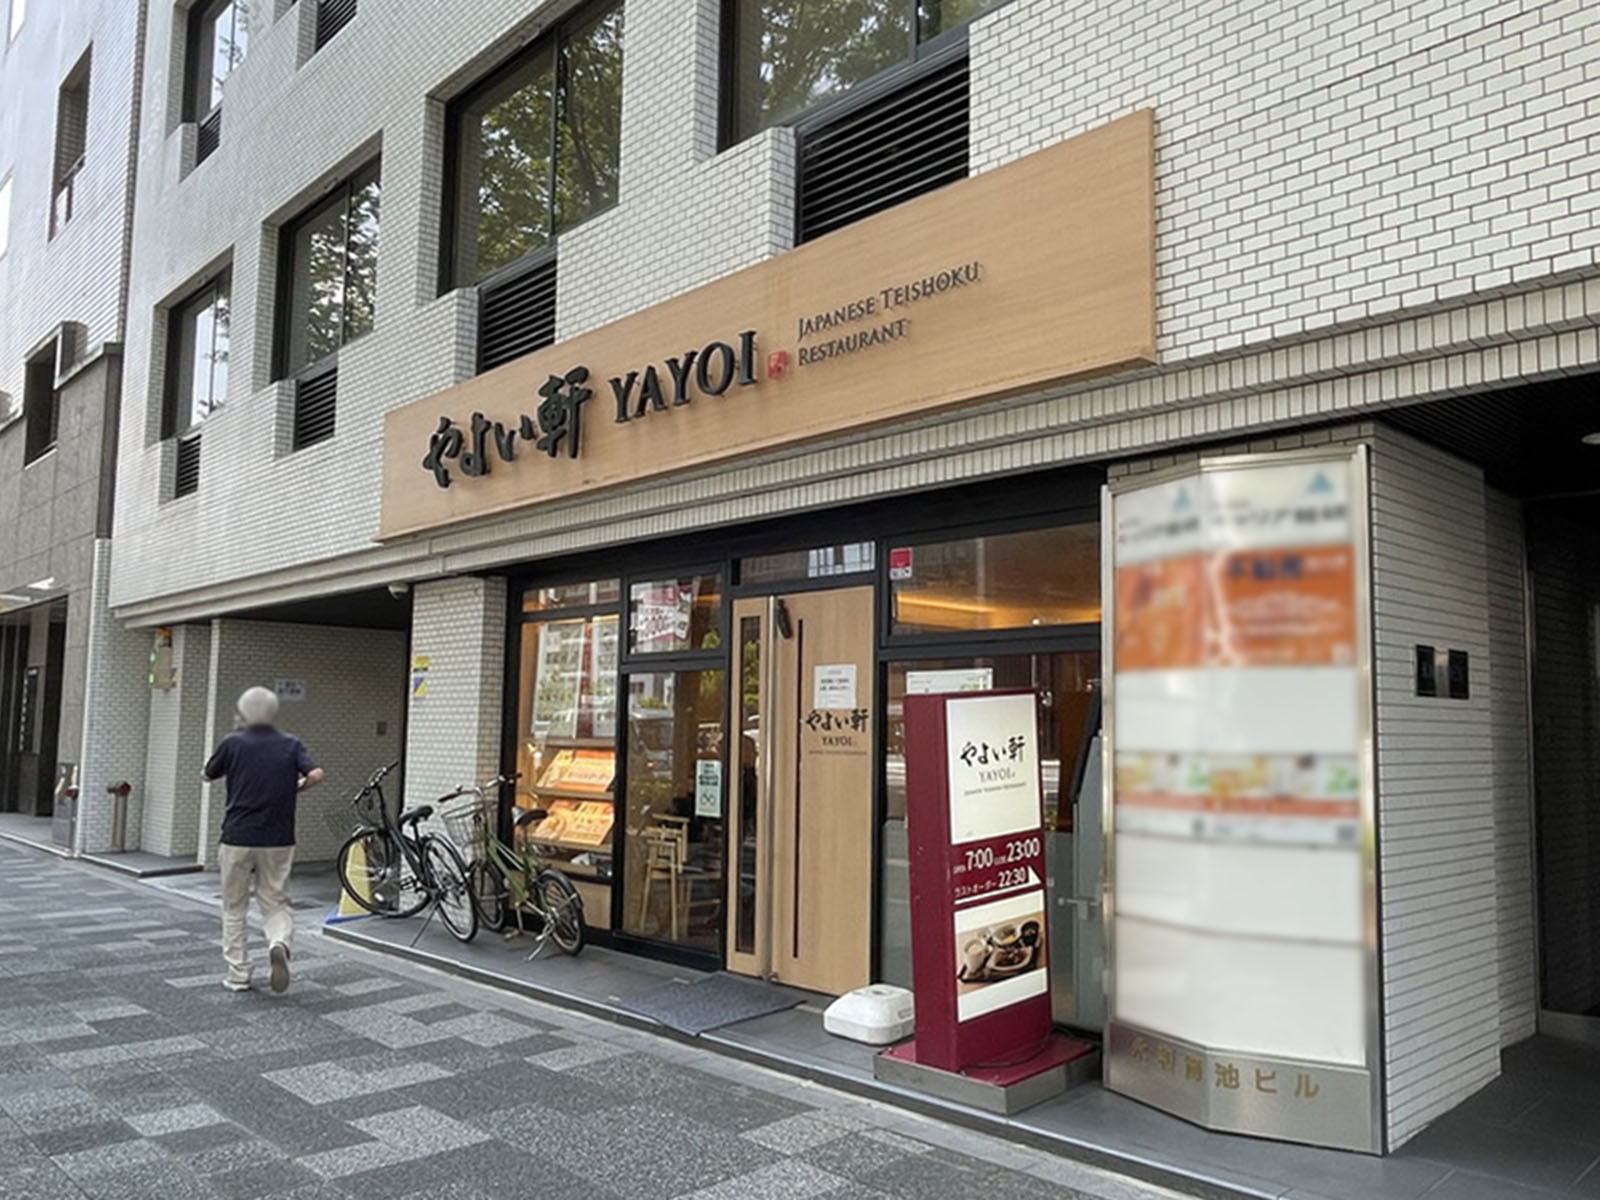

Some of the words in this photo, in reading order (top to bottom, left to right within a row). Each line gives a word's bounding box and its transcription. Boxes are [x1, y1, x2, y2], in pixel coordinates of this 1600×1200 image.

[798, 297, 875, 342] JAPANESE
[881, 262, 979, 309] TEISHOKU
[798, 319, 908, 366] RESTAURANT
[423, 366, 592, 488] やよい軒
[609, 331, 757, 423] YAYOI
[806, 708, 869, 733] やよい軒
[960, 736, 1025, 767] やよい軒
